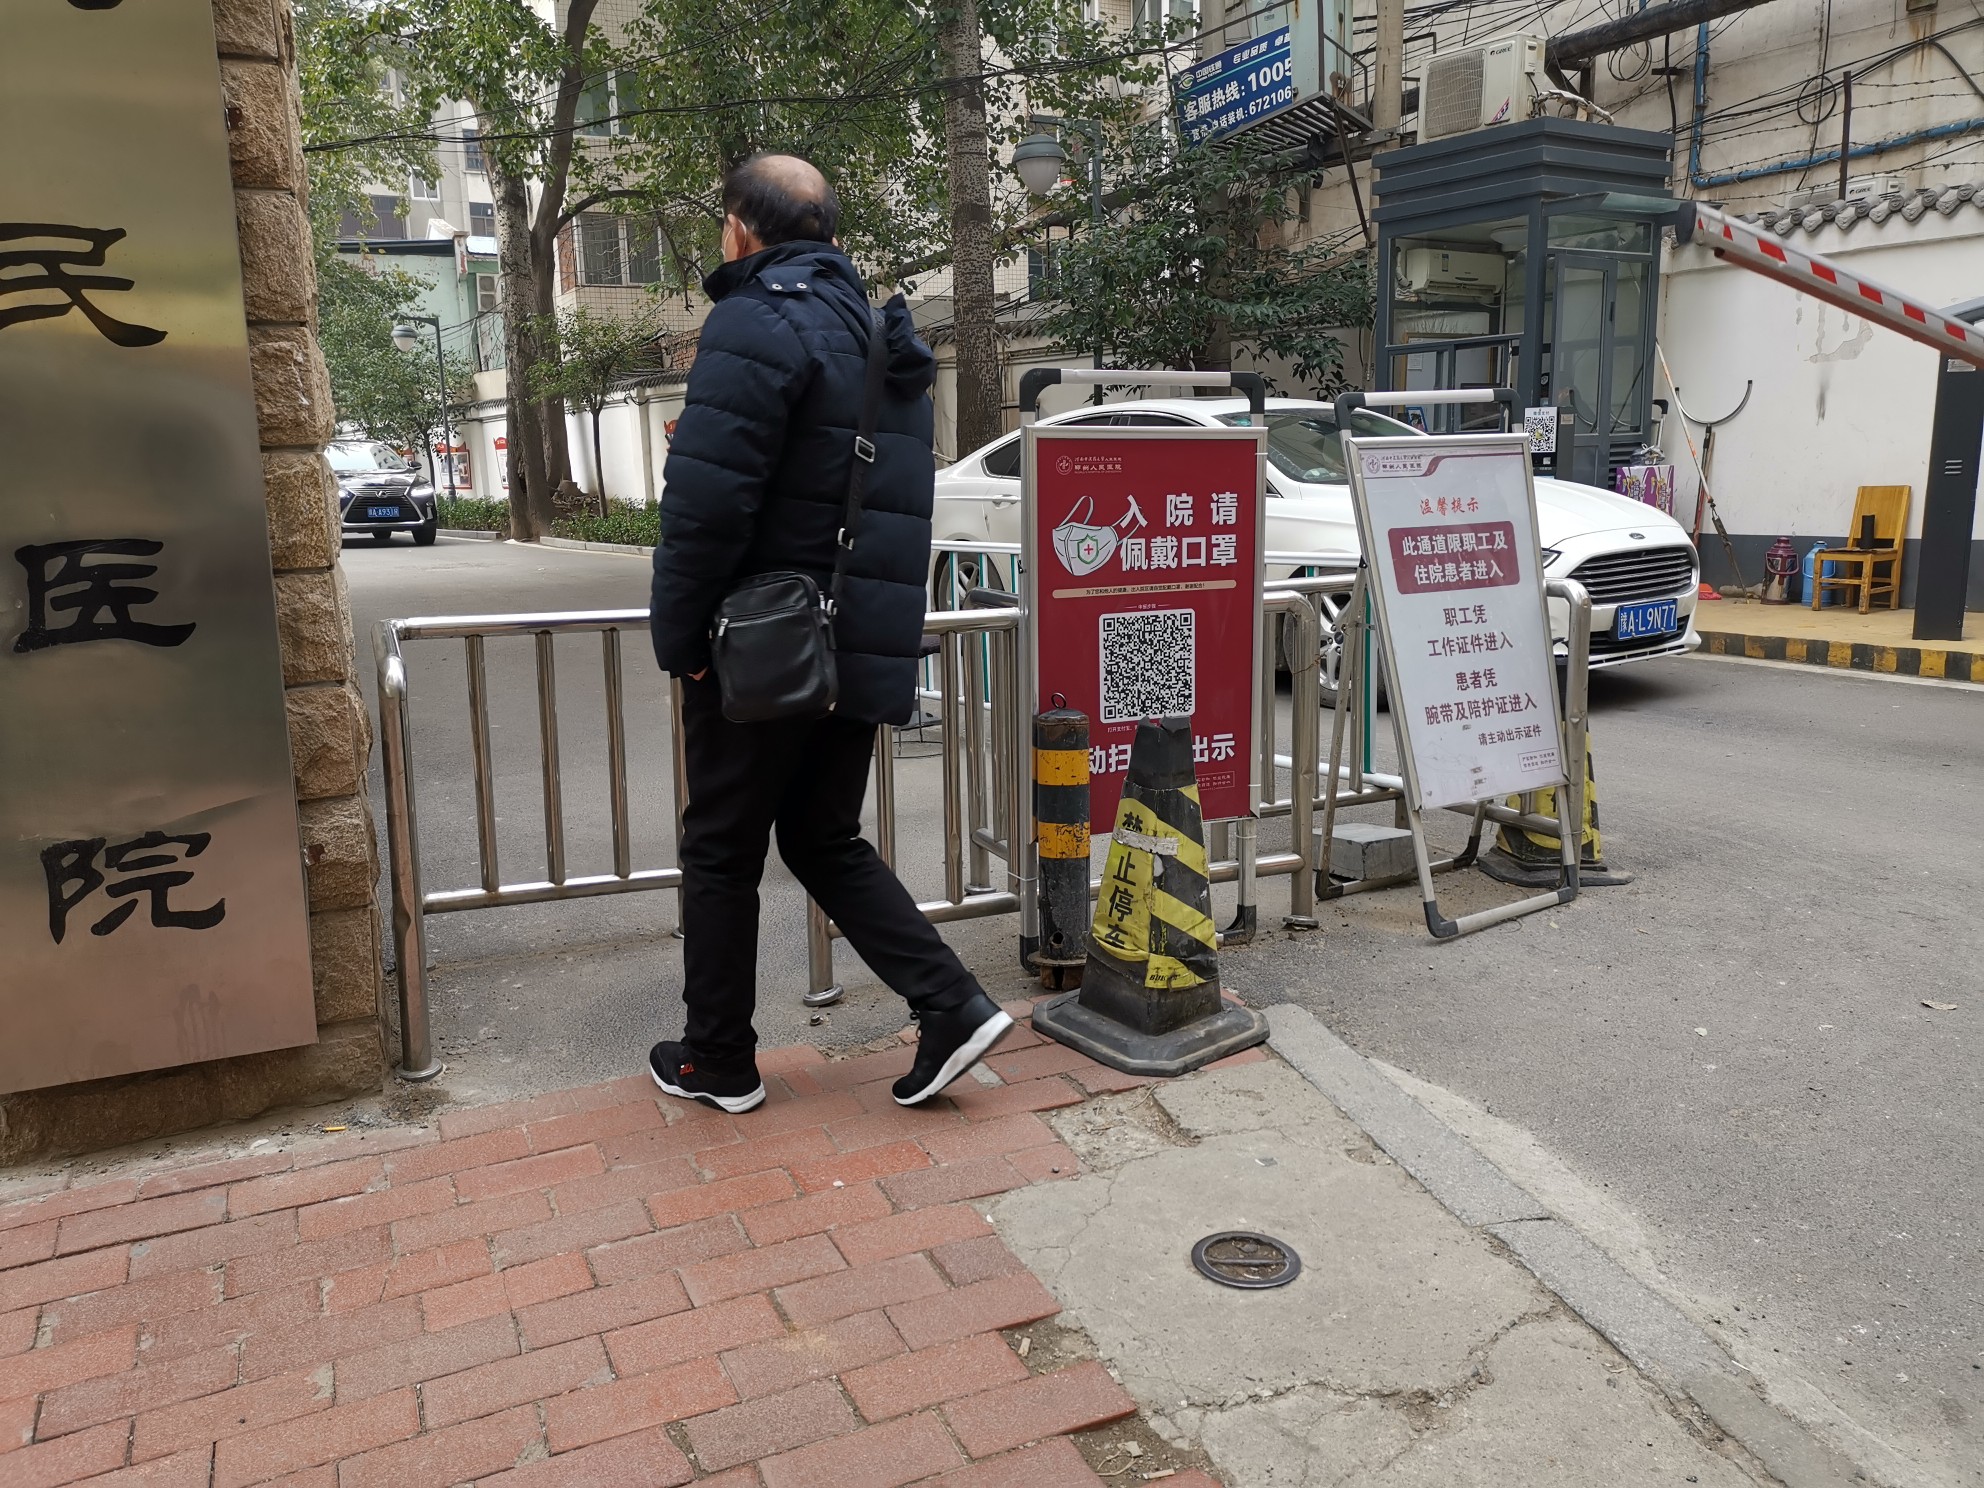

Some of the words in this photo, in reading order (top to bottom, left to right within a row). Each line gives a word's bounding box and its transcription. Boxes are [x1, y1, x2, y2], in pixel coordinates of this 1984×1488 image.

[0, 0, 225, 945] 民医院
[1120, 491, 1239, 529] 入院请
[1419, 497, 1480, 517] 温馨提示
[1119, 534, 1239, 572] 佩戴口罩
[1402, 530, 1509, 557] 此通道限职工及
[1413, 560, 1504, 586] 住院患者进入
[1443, 604, 1488, 627] 职工凭
[1427, 631, 1514, 657] 工作证件进入
[1455, 668, 1499, 691] 患者凭
[1424, 692, 1538, 726] 腕带及陪护证进入
[1477, 724, 1542, 746] 请主动出示证件
